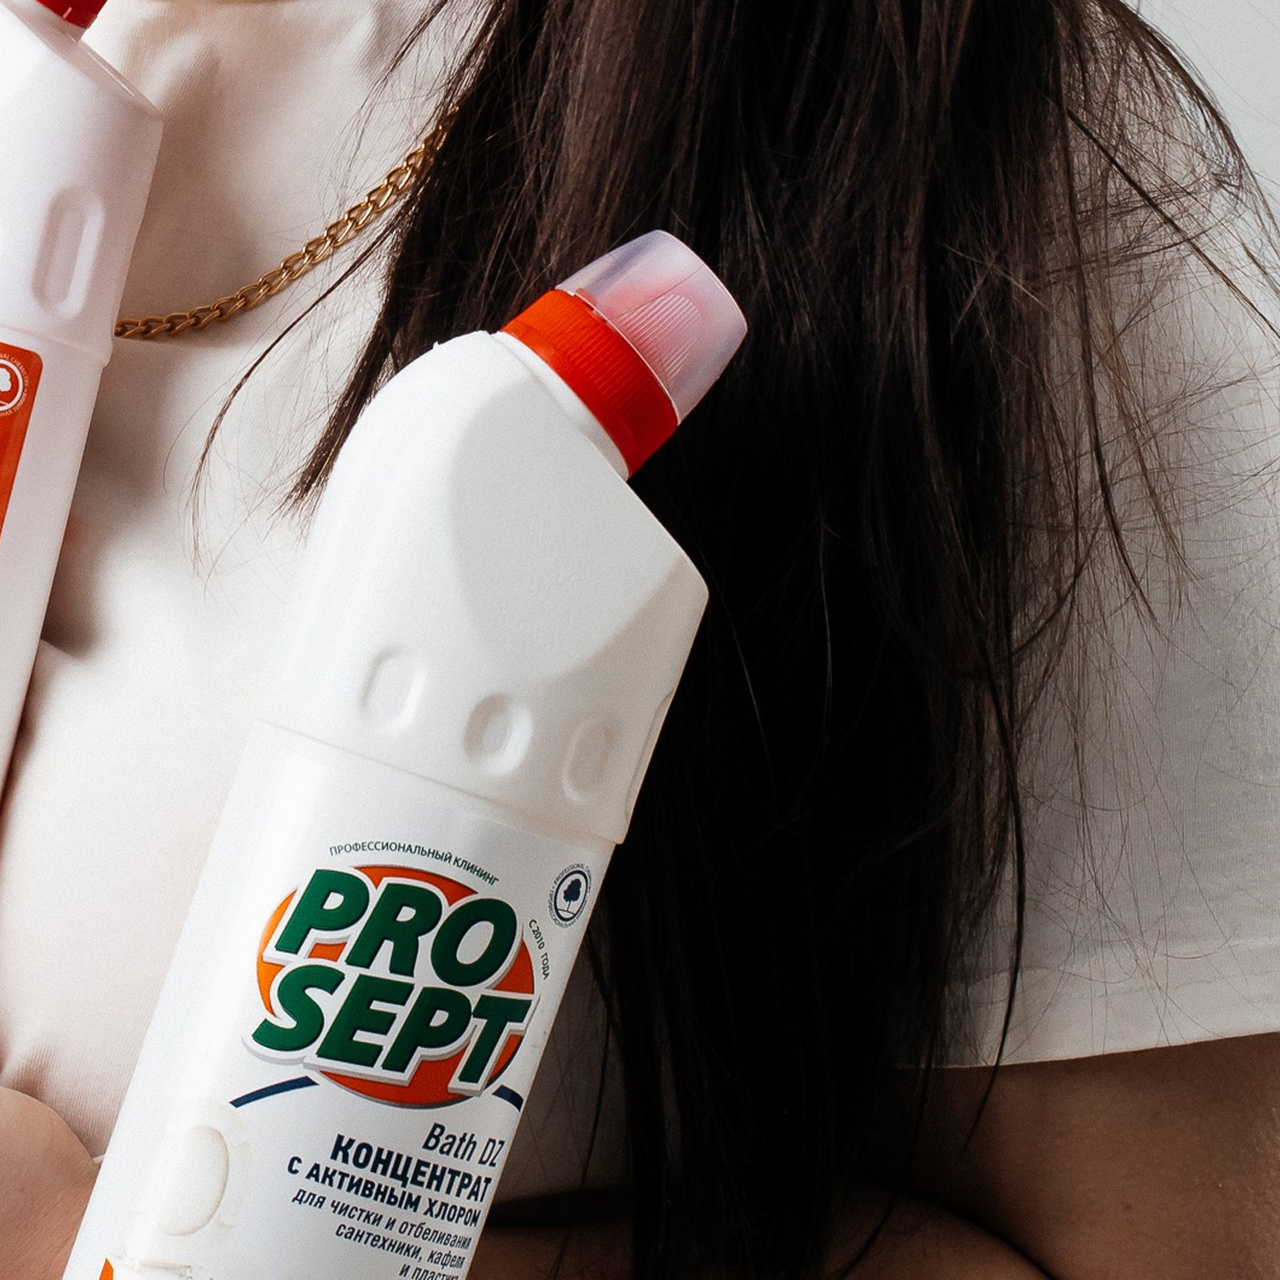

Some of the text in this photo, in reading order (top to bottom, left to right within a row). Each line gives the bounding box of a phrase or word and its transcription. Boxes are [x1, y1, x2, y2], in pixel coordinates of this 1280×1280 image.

[329, 840, 500, 886] ПРОФЕССИОНАЛЬНЫЙ КЛИНИНГ
[274, 867, 519, 988] PRO
[541, 952, 550, 980] ГОДА
[250, 963, 536, 1084] SEPT
[330, 1133, 492, 1203] КОНЦЕНТРАТ
[422, 1122, 506, 1168] Bath DZ
[291, 1188, 473, 1250] для чистки и отбеливания
[305, 1162, 422, 1214] АКТИВНЫМ
[424, 1197, 482, 1227] ХЛОРОМ
[335, 1223, 424, 1262] сантехники,
[399, 1263, 412, 1278] и
